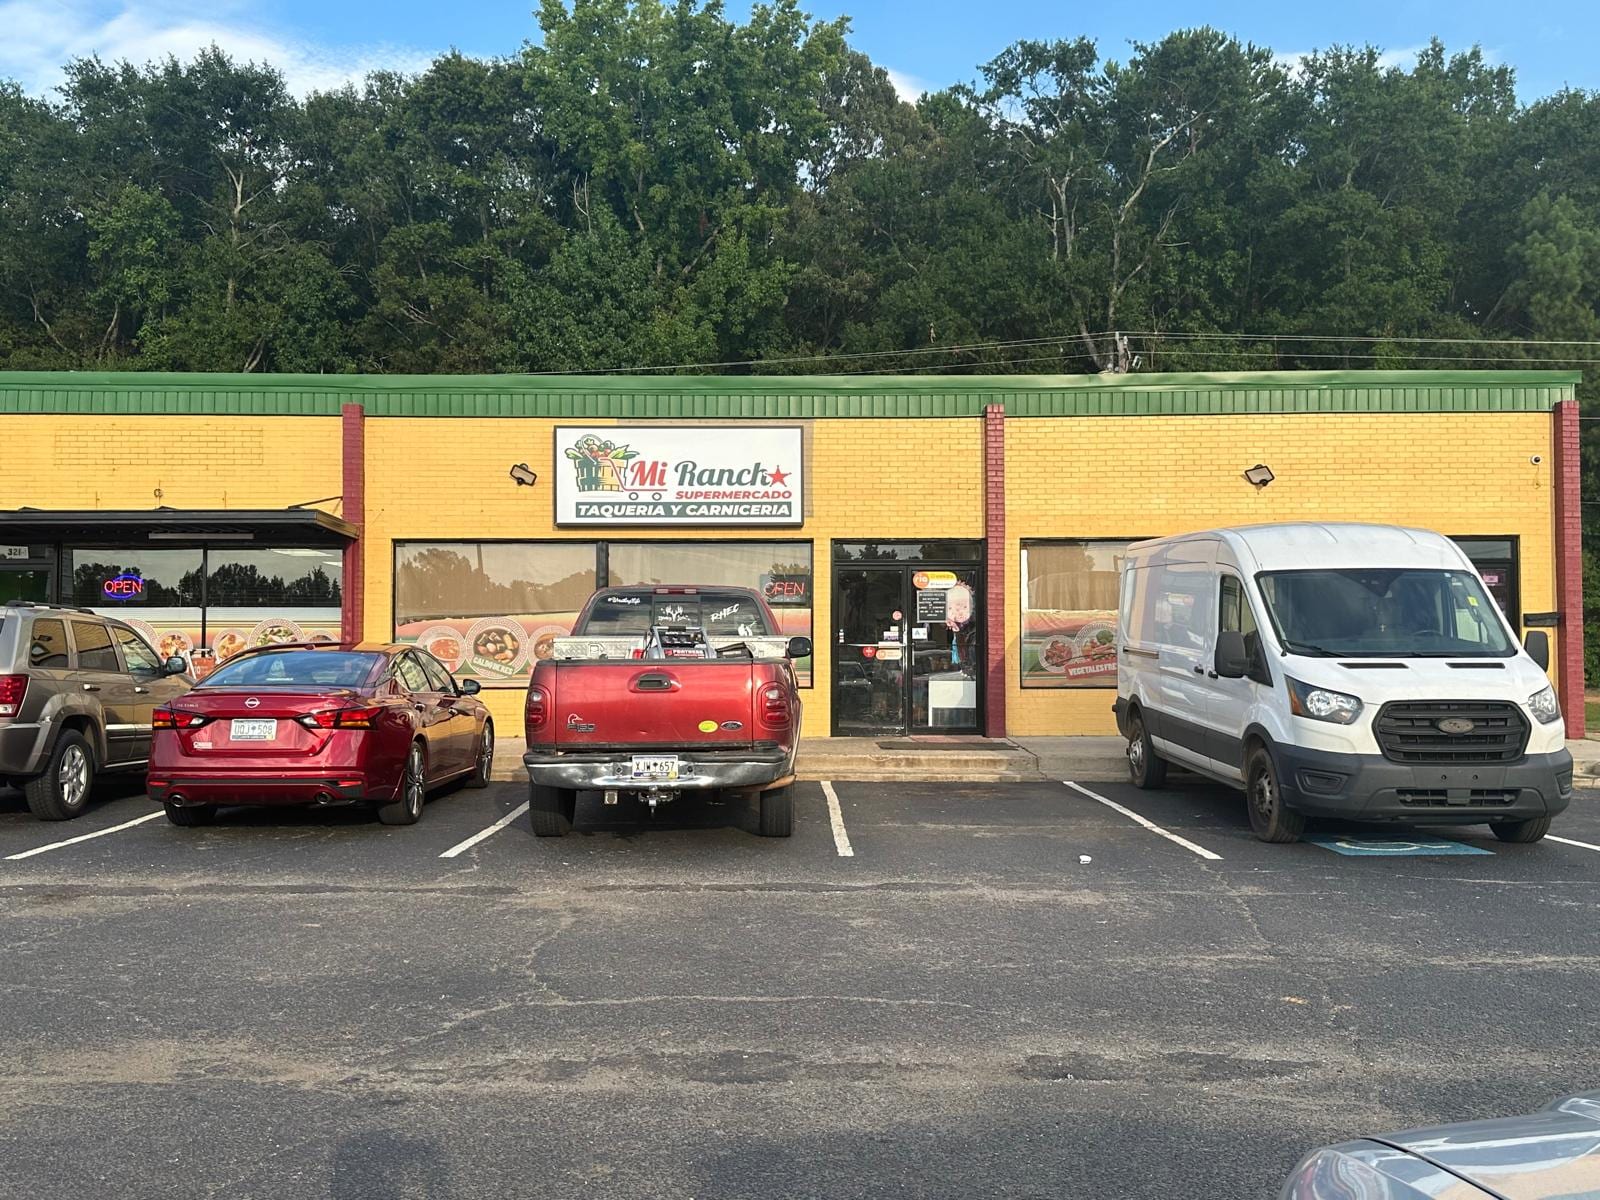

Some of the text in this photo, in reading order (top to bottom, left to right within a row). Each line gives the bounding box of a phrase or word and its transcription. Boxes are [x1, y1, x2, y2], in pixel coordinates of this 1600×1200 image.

[630, 460, 668, 487] Mi
[675, 490, 792, 500] SUPERMERCADO
[578, 504, 790, 517] TAQUERIA Y CARNICERIA
[104, 580, 142, 593] OPEN
[763, 581, 805, 596] OPEN
[659, 761, 675, 771] 657
